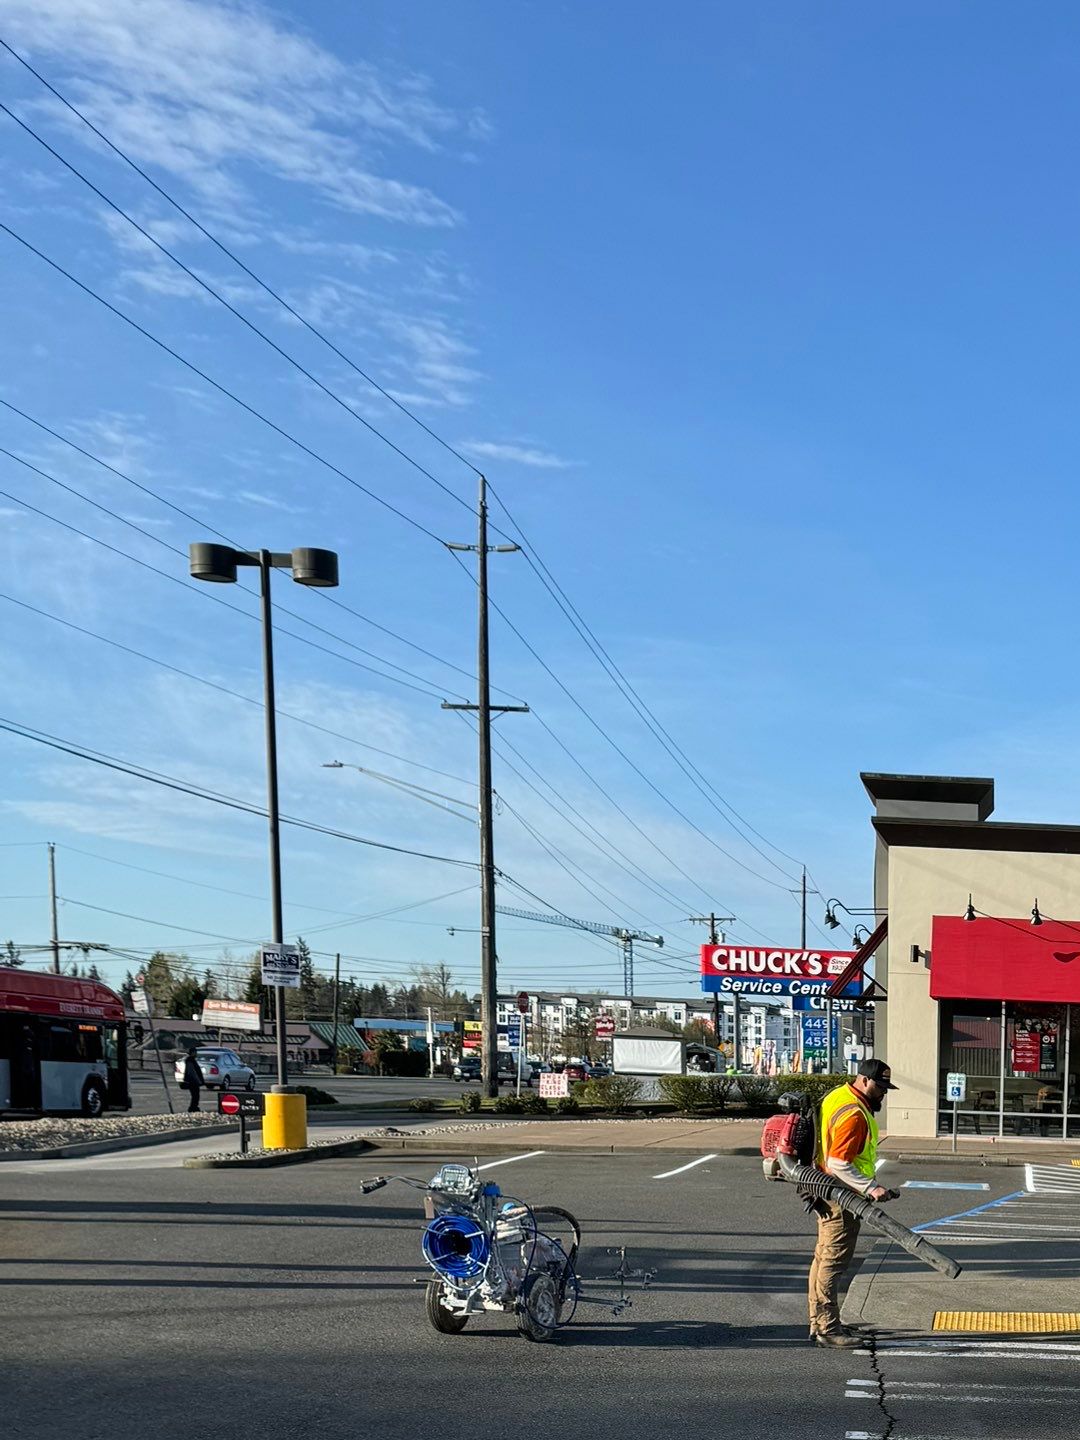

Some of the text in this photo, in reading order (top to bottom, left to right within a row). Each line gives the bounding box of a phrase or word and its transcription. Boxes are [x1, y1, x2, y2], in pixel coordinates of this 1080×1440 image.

[711, 949, 822, 975] CHUCK'S
[720, 977, 832, 995] Service Cent
